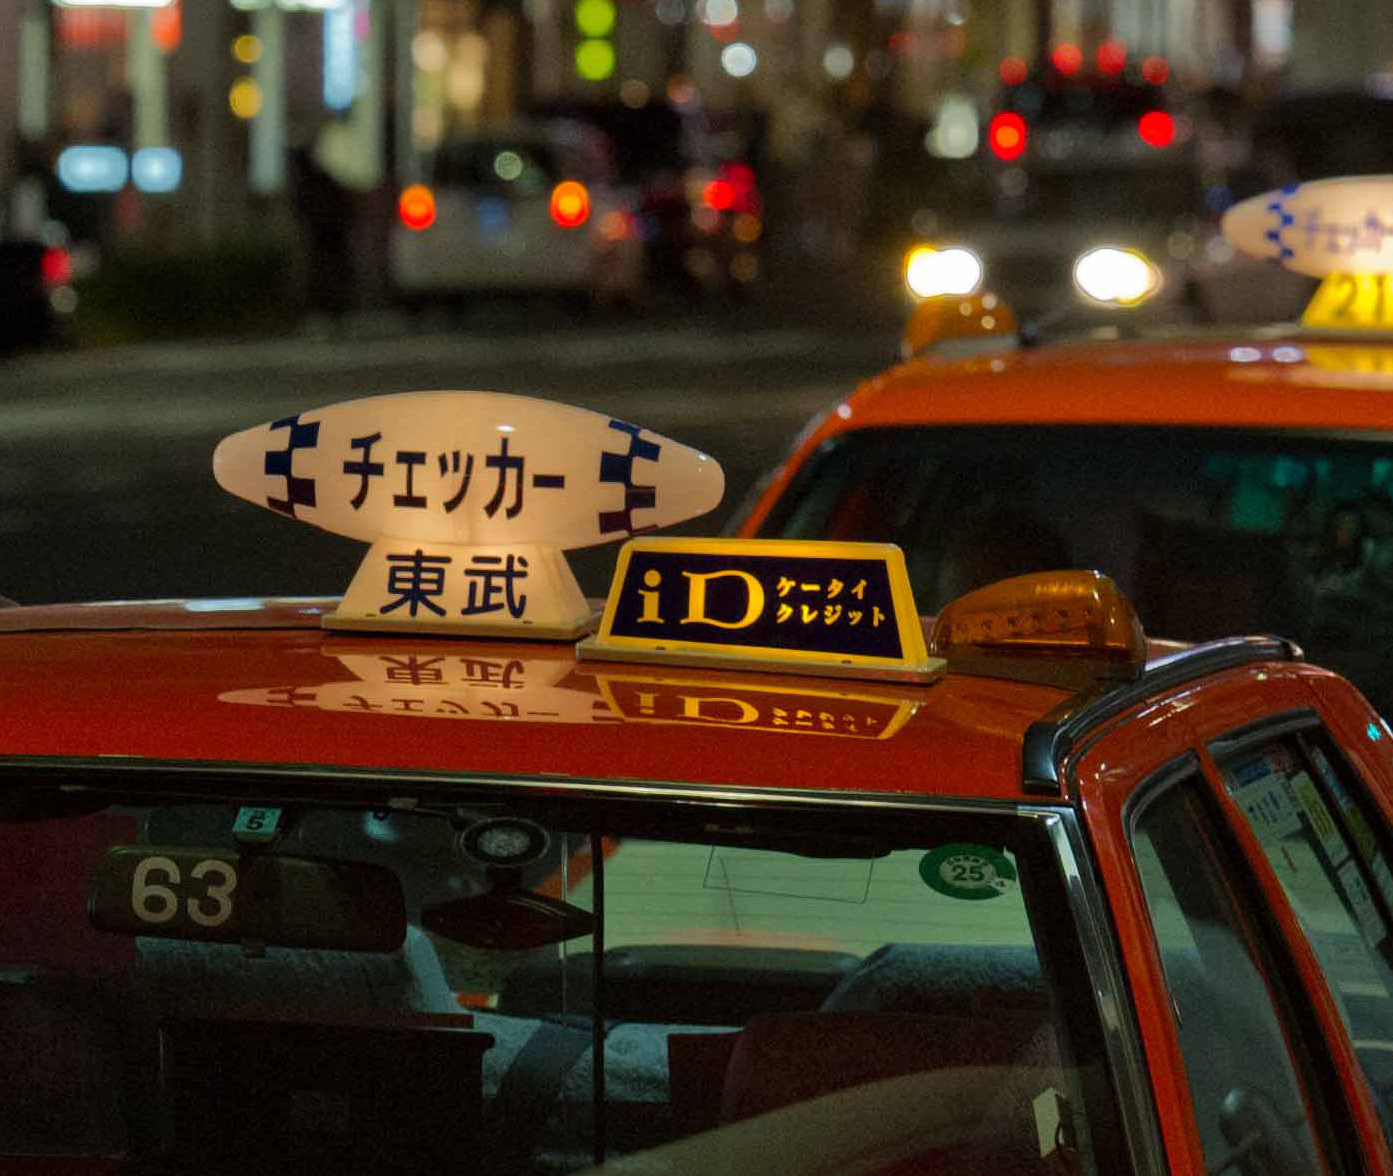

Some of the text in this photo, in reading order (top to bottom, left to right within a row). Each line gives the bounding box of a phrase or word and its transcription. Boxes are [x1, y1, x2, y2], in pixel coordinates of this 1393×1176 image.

[343, 431, 566, 520] チェッカー
[379, 548, 530, 619] 東武
[637, 568, 765, 630] iD
[775, 576, 868, 601] ケータイ
[775, 602, 886, 627] クレジット
[131, 856, 237, 928] 63
[951, 865, 985, 882] 25
